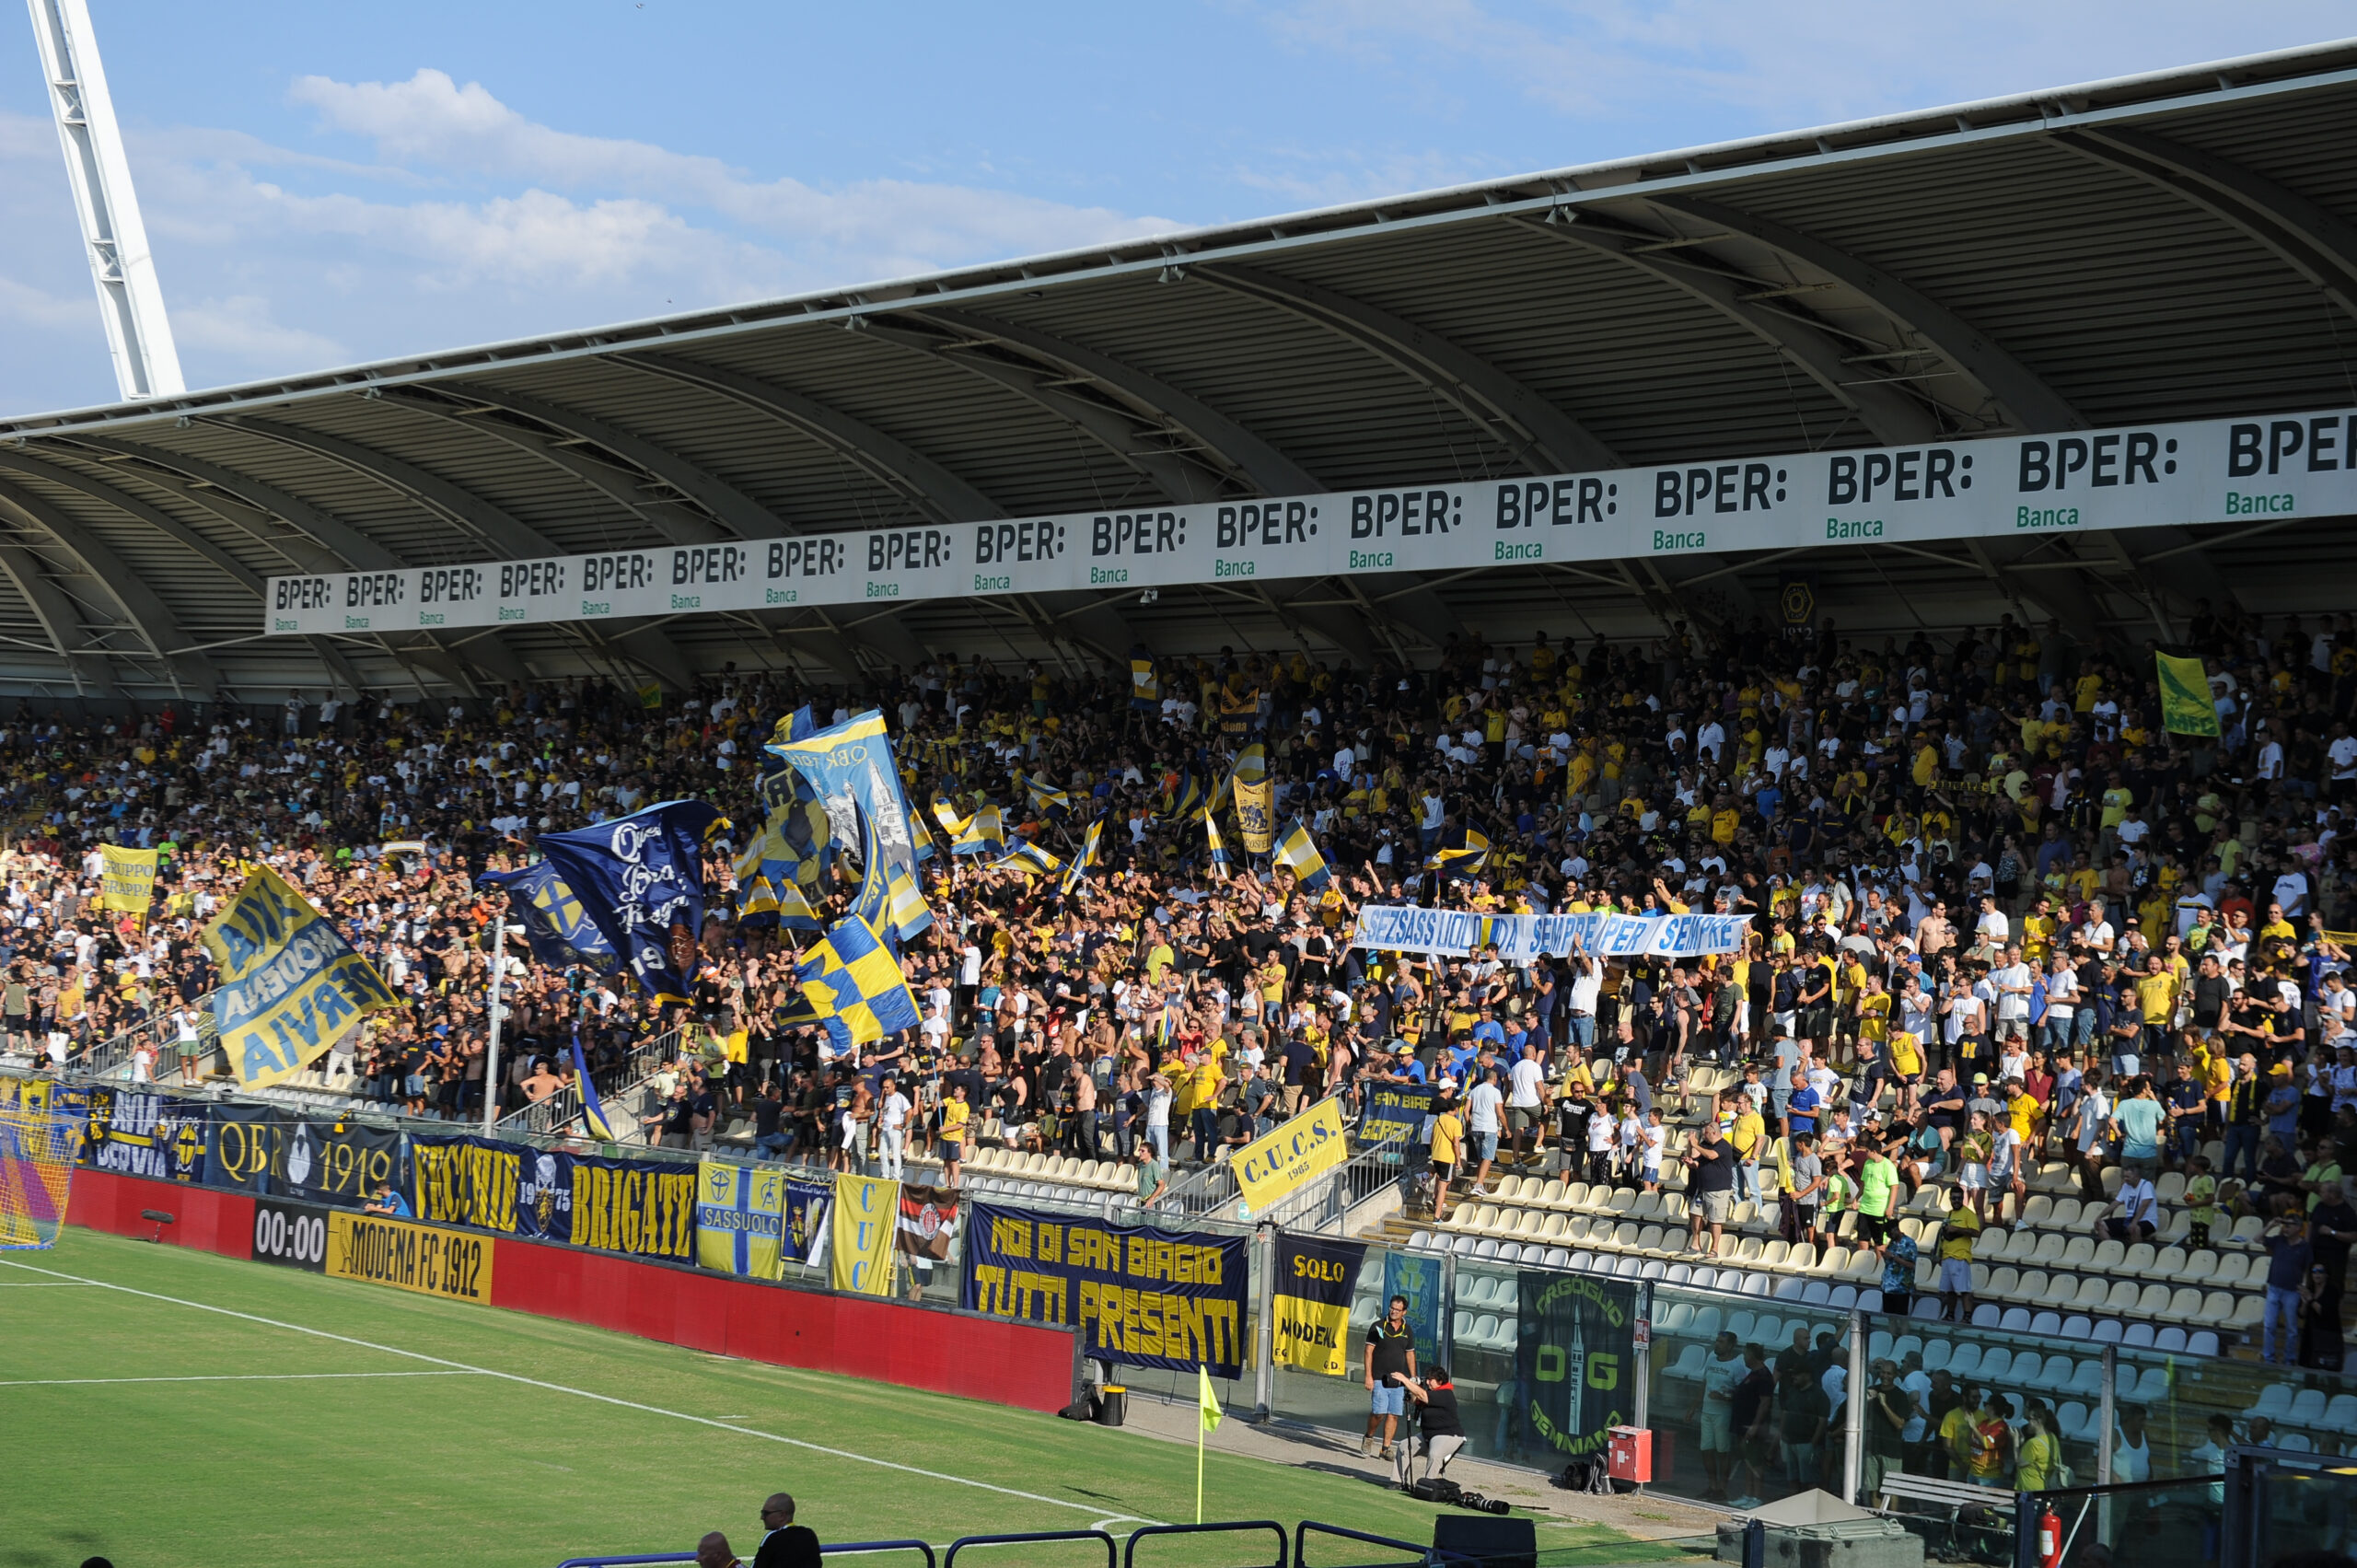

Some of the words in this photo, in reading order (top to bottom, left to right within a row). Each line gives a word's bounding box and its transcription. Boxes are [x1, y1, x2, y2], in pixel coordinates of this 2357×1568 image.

[1828, 448, 1972, 505] BPER:
[2018, 432, 2177, 493] BPER:
[1496, 476, 1617, 528] BPER:
[1655, 463, 1787, 518] BPER:
[2225, 491, 2294, 516] Banca
[1216, 500, 1318, 548] BPER:
[1351, 489, 1462, 539] BPER:
[1826, 517, 1884, 539] Banca
[2016, 504, 2079, 528] Banca
[976, 521, 1064, 563] BPER:
[1092, 511, 1186, 556] BPER:
[1653, 529, 1706, 551] Banca
[672, 546, 746, 585] BPER:
[767, 539, 844, 578] BPER:
[867, 528, 950, 572] BPER:
[1349, 549, 1393, 569] Banca
[1494, 540, 1543, 561] Banca
[500, 562, 564, 598] BPER:
[583, 554, 653, 591] BPER:
[974, 574, 1011, 591] Banca
[1090, 565, 1128, 584] Banca
[1214, 559, 1255, 577] Banca
[276, 578, 331, 610] BPER:
[346, 574, 404, 607] BPER:
[421, 568, 482, 602] BPER:
[766, 588, 797, 603] Banca
[865, 581, 900, 598] Banca
[498, 607, 525, 621] Banca
[582, 600, 610, 615] Banca
[671, 594, 701, 610] Banca
[275, 618, 298, 631] Banca
[345, 615, 369, 629] Banca
[420, 612, 445, 625] Banca
[102, 859, 154, 877] GRUPPO
[103, 878, 150, 897] GRAPPA
[1529, 915, 1597, 953] SEMPRE
[1598, 919, 1648, 952] PER
[1659, 914, 1741, 951] SEMPRE
[629, 946, 665, 977] 19
[1374, 1092, 1399, 1108] SAN
[1401, 1095, 1433, 1110] BIAG
[1244, 1118, 1338, 1183] C.U.C.S.
[1287, 1162, 1310, 1181] 1985
[520, 1181, 535, 1205] 19
[555, 1188, 571, 1212] 75
[570, 1165, 696, 1257] BRIGATE
[704, 1208, 780, 1236] SASSUOLO
[256, 1208, 325, 1262] 00:00
[992, 1216, 1032, 1259] NOI
[1038, 1223, 1062, 1263] DI
[1068, 1226, 1120, 1273] SAN
[1128, 1236, 1223, 1285] BIAGIO
[352, 1220, 415, 1285] MODENA
[419, 1232, 439, 1290] FC
[441, 1236, 482, 1297] 1912
[1293, 1254, 1345, 1283] SOLO
[975, 1263, 1068, 1325] TUTTI
[1079, 1280, 1240, 1366] PRESENTI
[1536, 1276, 1624, 1328] ORGOGLIO
[1535, 1344, 1566, 1382] O
[1587, 1351, 1619, 1390] G
